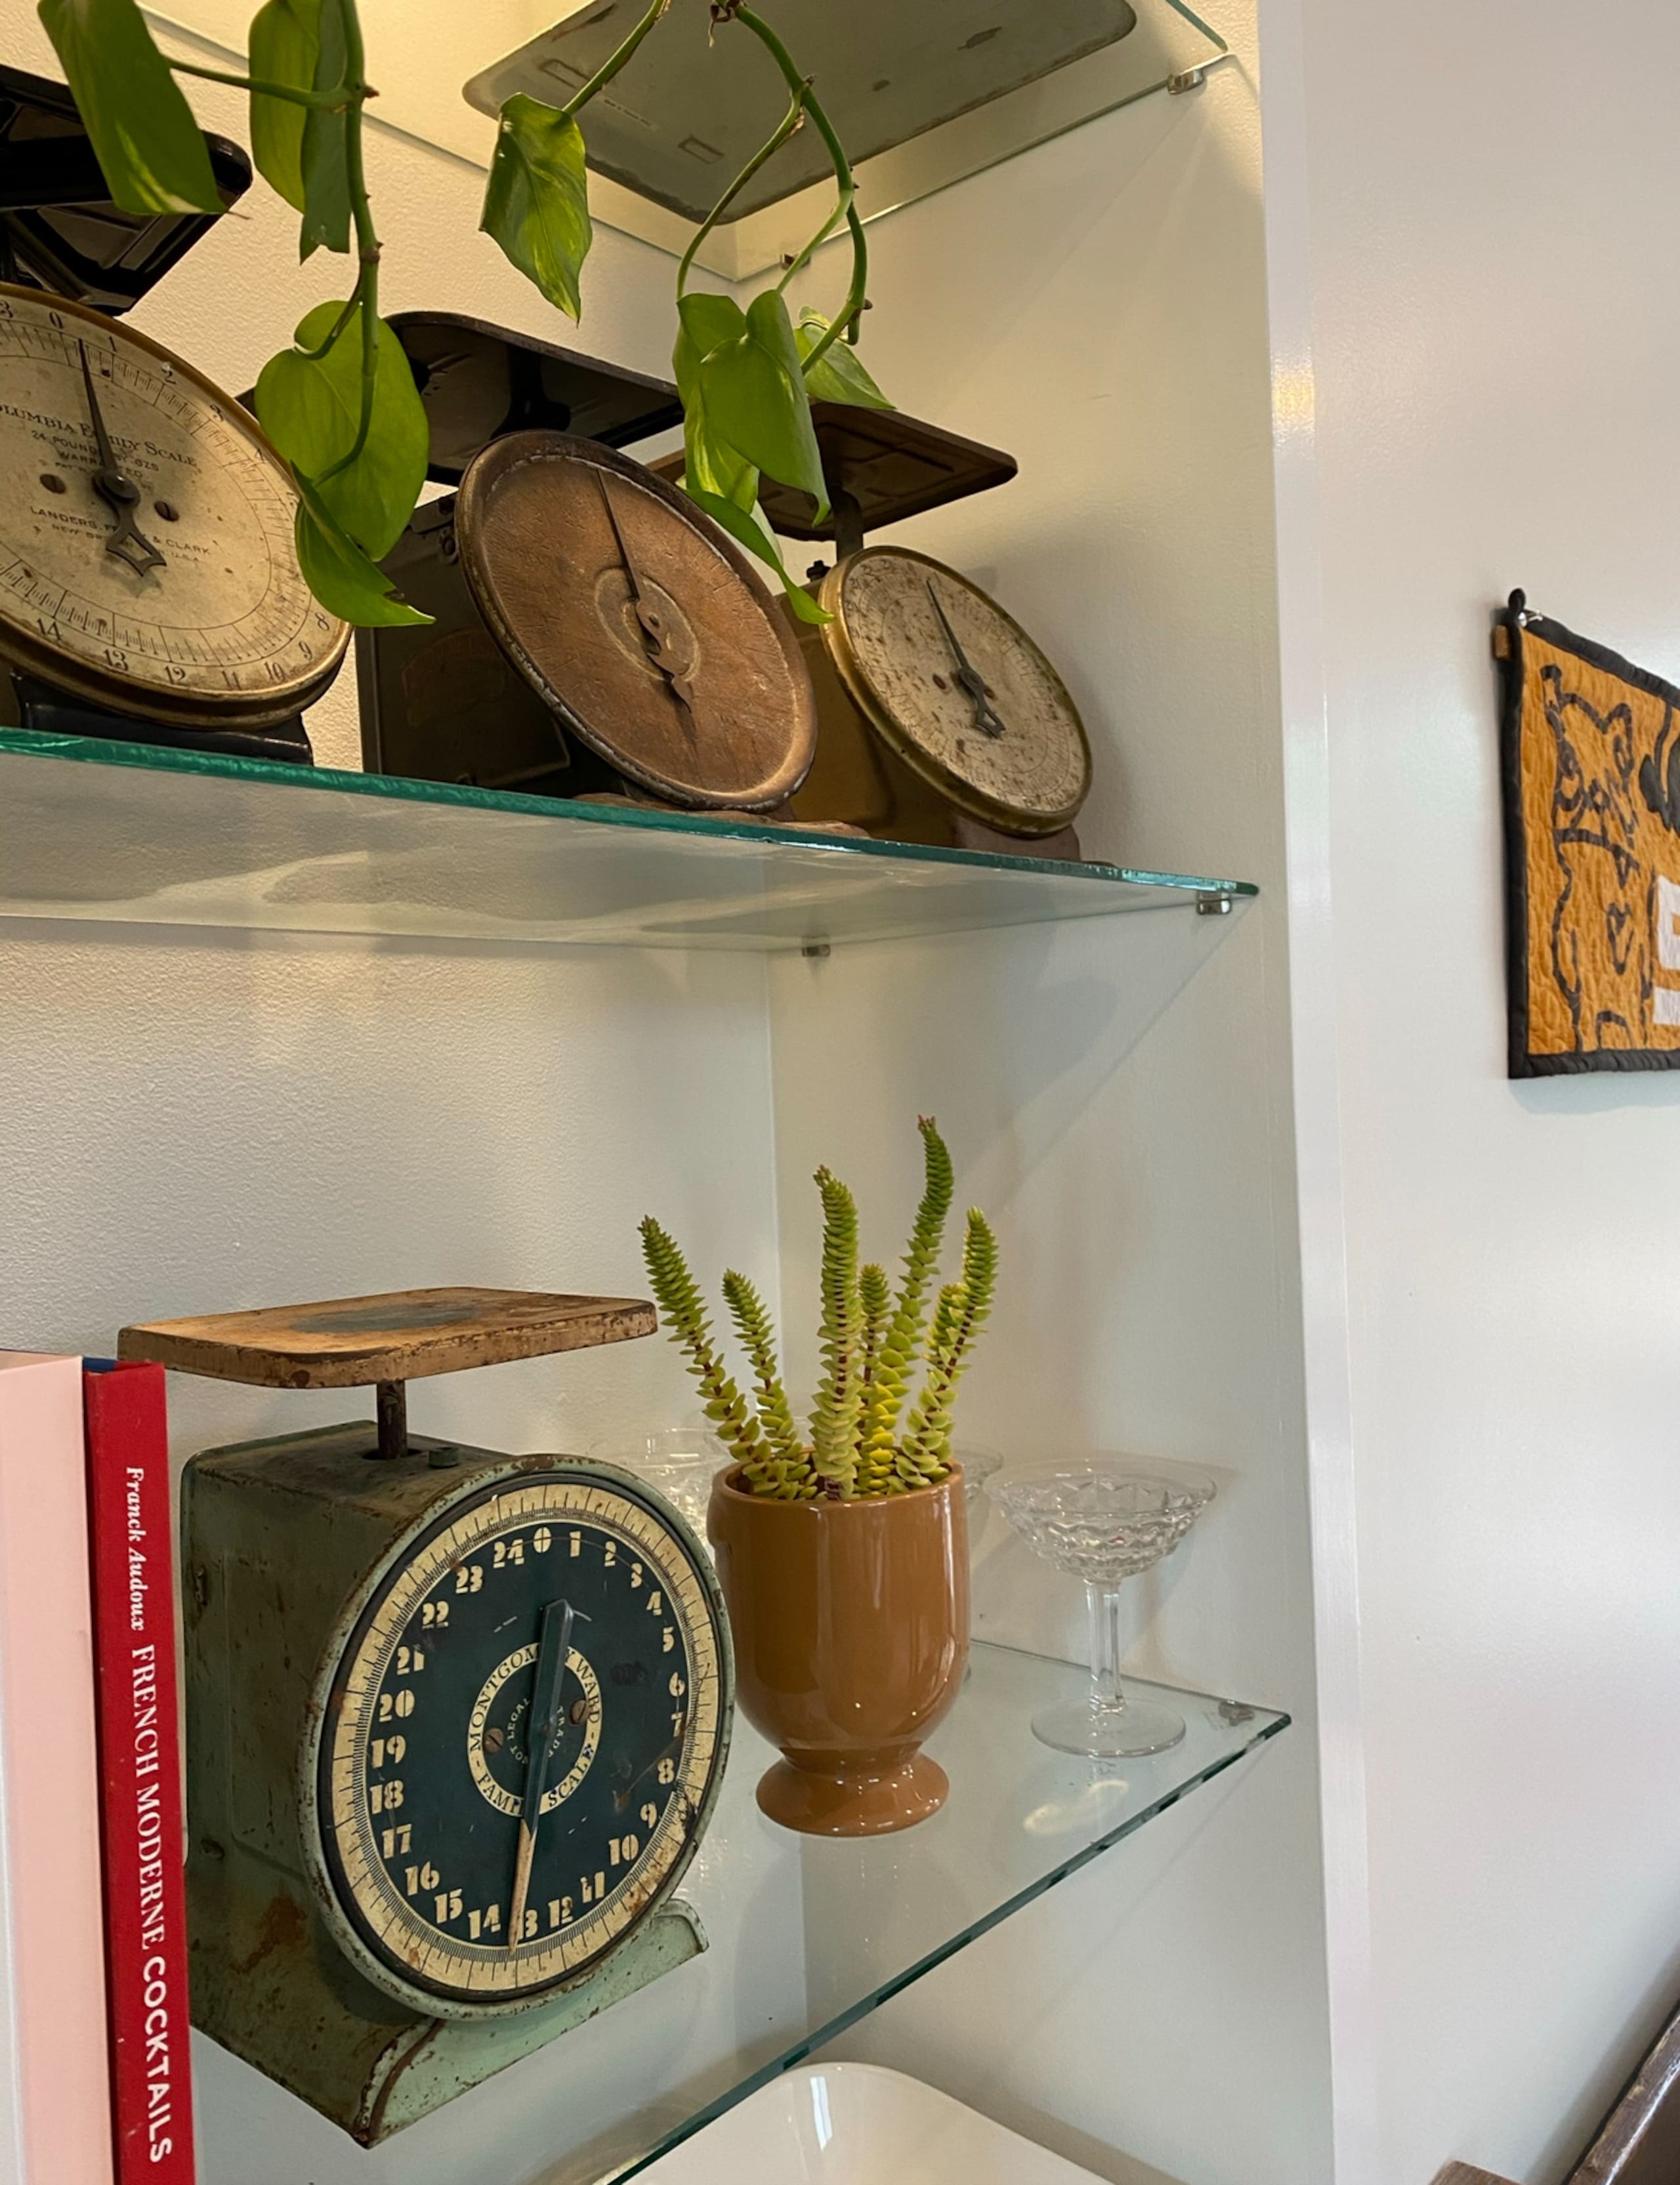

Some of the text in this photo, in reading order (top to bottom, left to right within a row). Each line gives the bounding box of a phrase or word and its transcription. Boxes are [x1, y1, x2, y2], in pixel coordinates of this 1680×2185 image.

[49, 311, 63, 329] 0
[0, 404, 77, 434] LUMBIA
[166, 539, 211, 555] CLARK
[37, 617, 62, 642] 14
[315, 612, 329, 631] 8
[103, 648, 129, 671] 13
[299, 640, 313, 661] 9
[165, 665, 186, 684] 12
[221, 670, 241, 690] 11
[264, 661, 284, 682] 10
[127, 1467, 148, 1631] Franck Audoux
[493, 1539, 524, 1568] 24
[533, 1527, 552, 1553] 0
[570, 1531, 581, 1557] 1
[604, 1541, 617, 1566] 2
[455, 1565, 484, 1594] 23
[631, 1563, 643, 1588] 3
[422, 1600, 450, 1629] 22
[646, 1591, 662, 1615] 4
[663, 1627, 675, 1652] 5
[397, 1645, 425, 1675] 21
[576, 1659, 600, 1723] WARD
[669, 1672, 685, 1697] 6
[379, 1689, 415, 1722] 20
[671, 1712, 683, 1738] 7
[371, 1735, 406, 1769] 19
[658, 1758, 675, 1785] 8
[369, 1779, 404, 1814] 18
[640, 1801, 656, 1829] 9
[381, 1823, 412, 1859] 17
[609, 1834, 639, 1865] 10
[405, 1862, 440, 1896] 16
[580, 1871, 605, 1904] 11
[132, 1644, 172, 2163] FRENCH MODERNE COCKTAILS
[434, 1888, 463, 1924] 15
[548, 1896, 574, 1928] 12
[468, 1904, 501, 1940] 14
